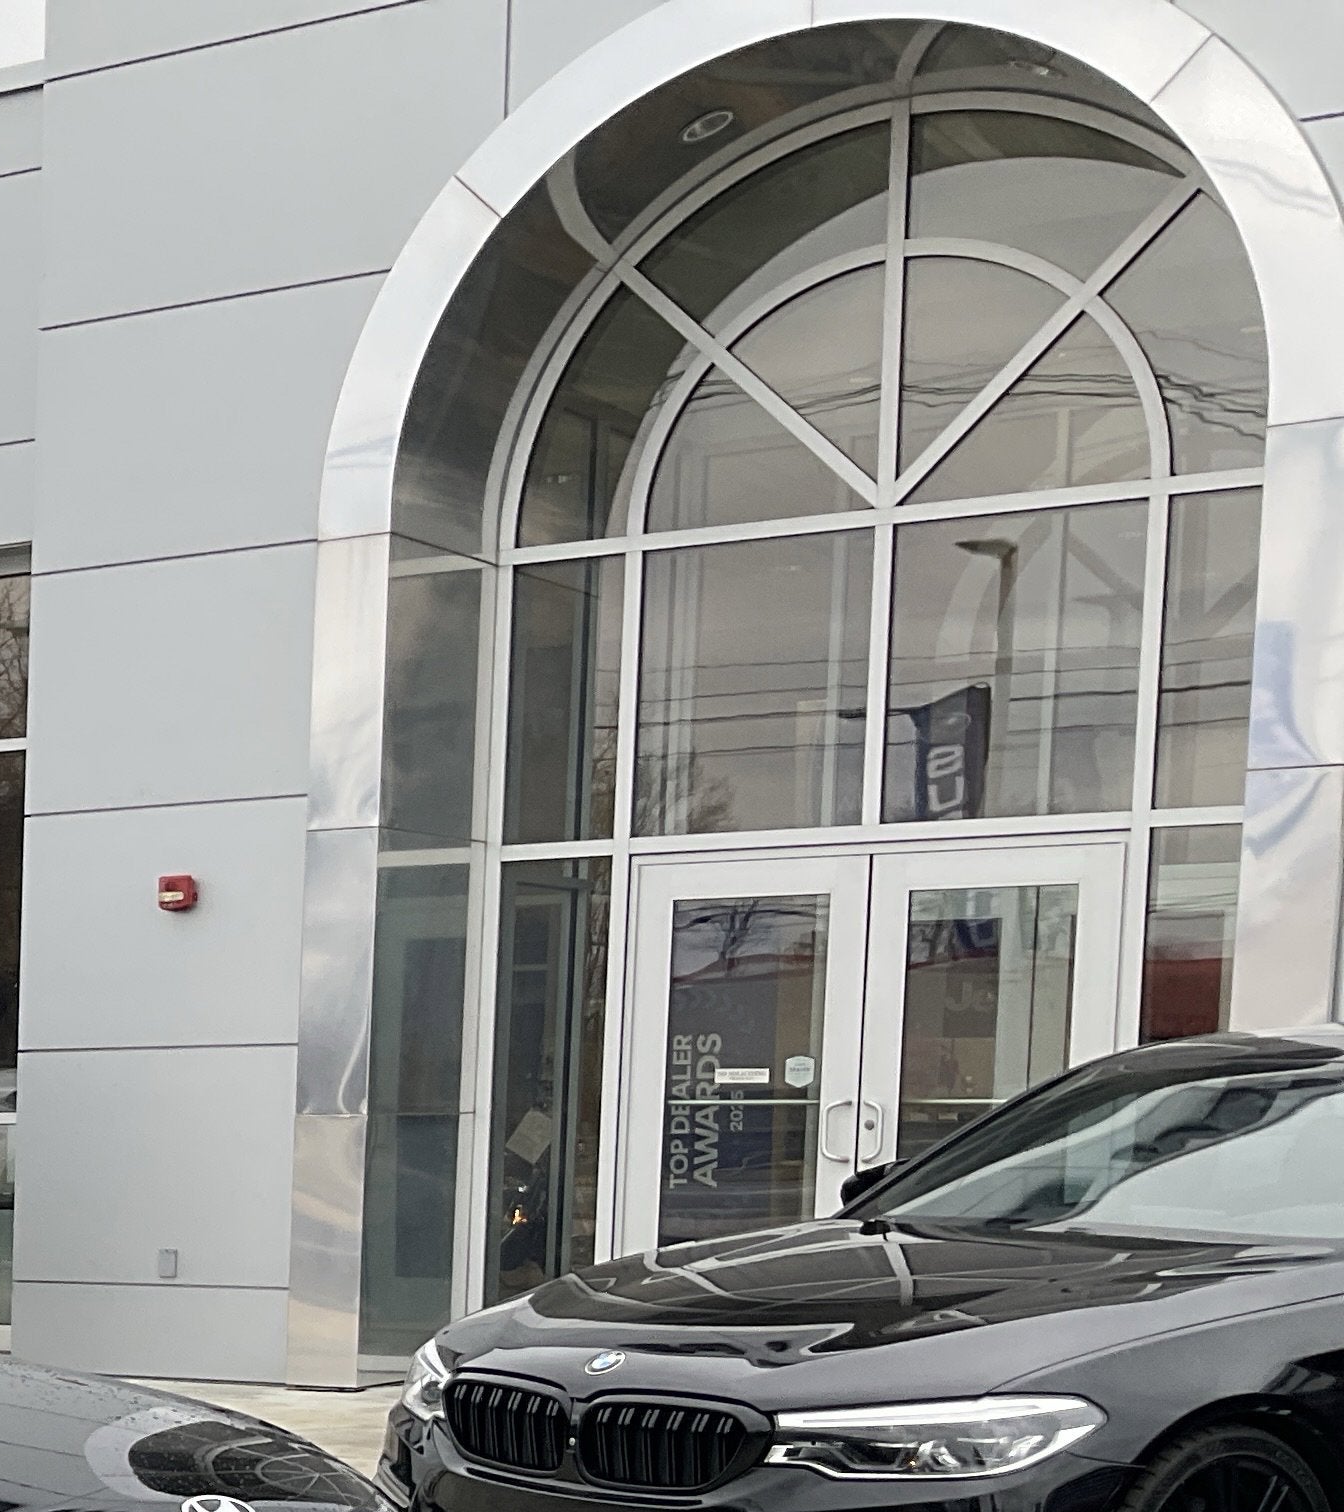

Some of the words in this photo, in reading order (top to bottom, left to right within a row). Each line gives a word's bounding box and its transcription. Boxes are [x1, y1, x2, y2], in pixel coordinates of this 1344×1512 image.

[671, 1034, 693, 1135] DEALER
[693, 1033, 722, 1188] AWARDS
[669, 1139, 689, 1189] TOP
